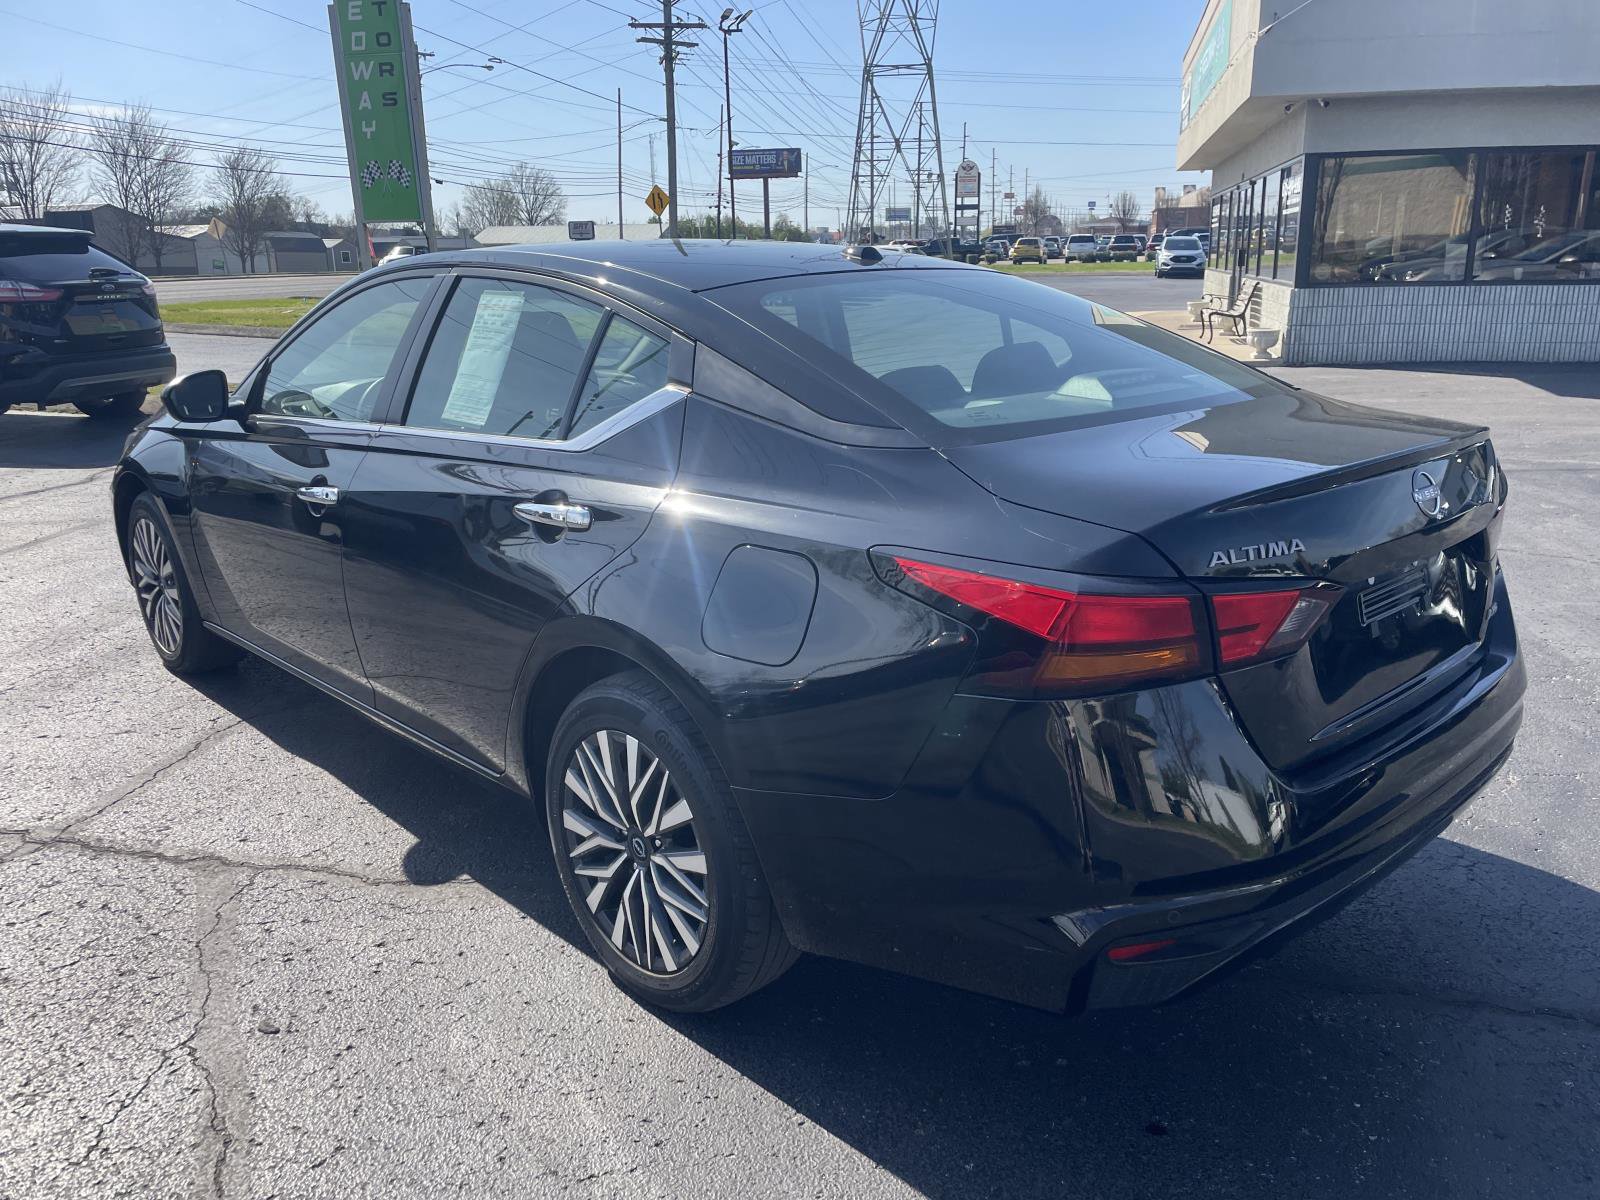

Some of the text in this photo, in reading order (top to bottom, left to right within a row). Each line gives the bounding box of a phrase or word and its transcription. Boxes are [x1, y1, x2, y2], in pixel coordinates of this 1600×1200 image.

[733, 154, 776, 164] IZE MATTERS
[1209, 539, 1306, 568] ALTIMA
